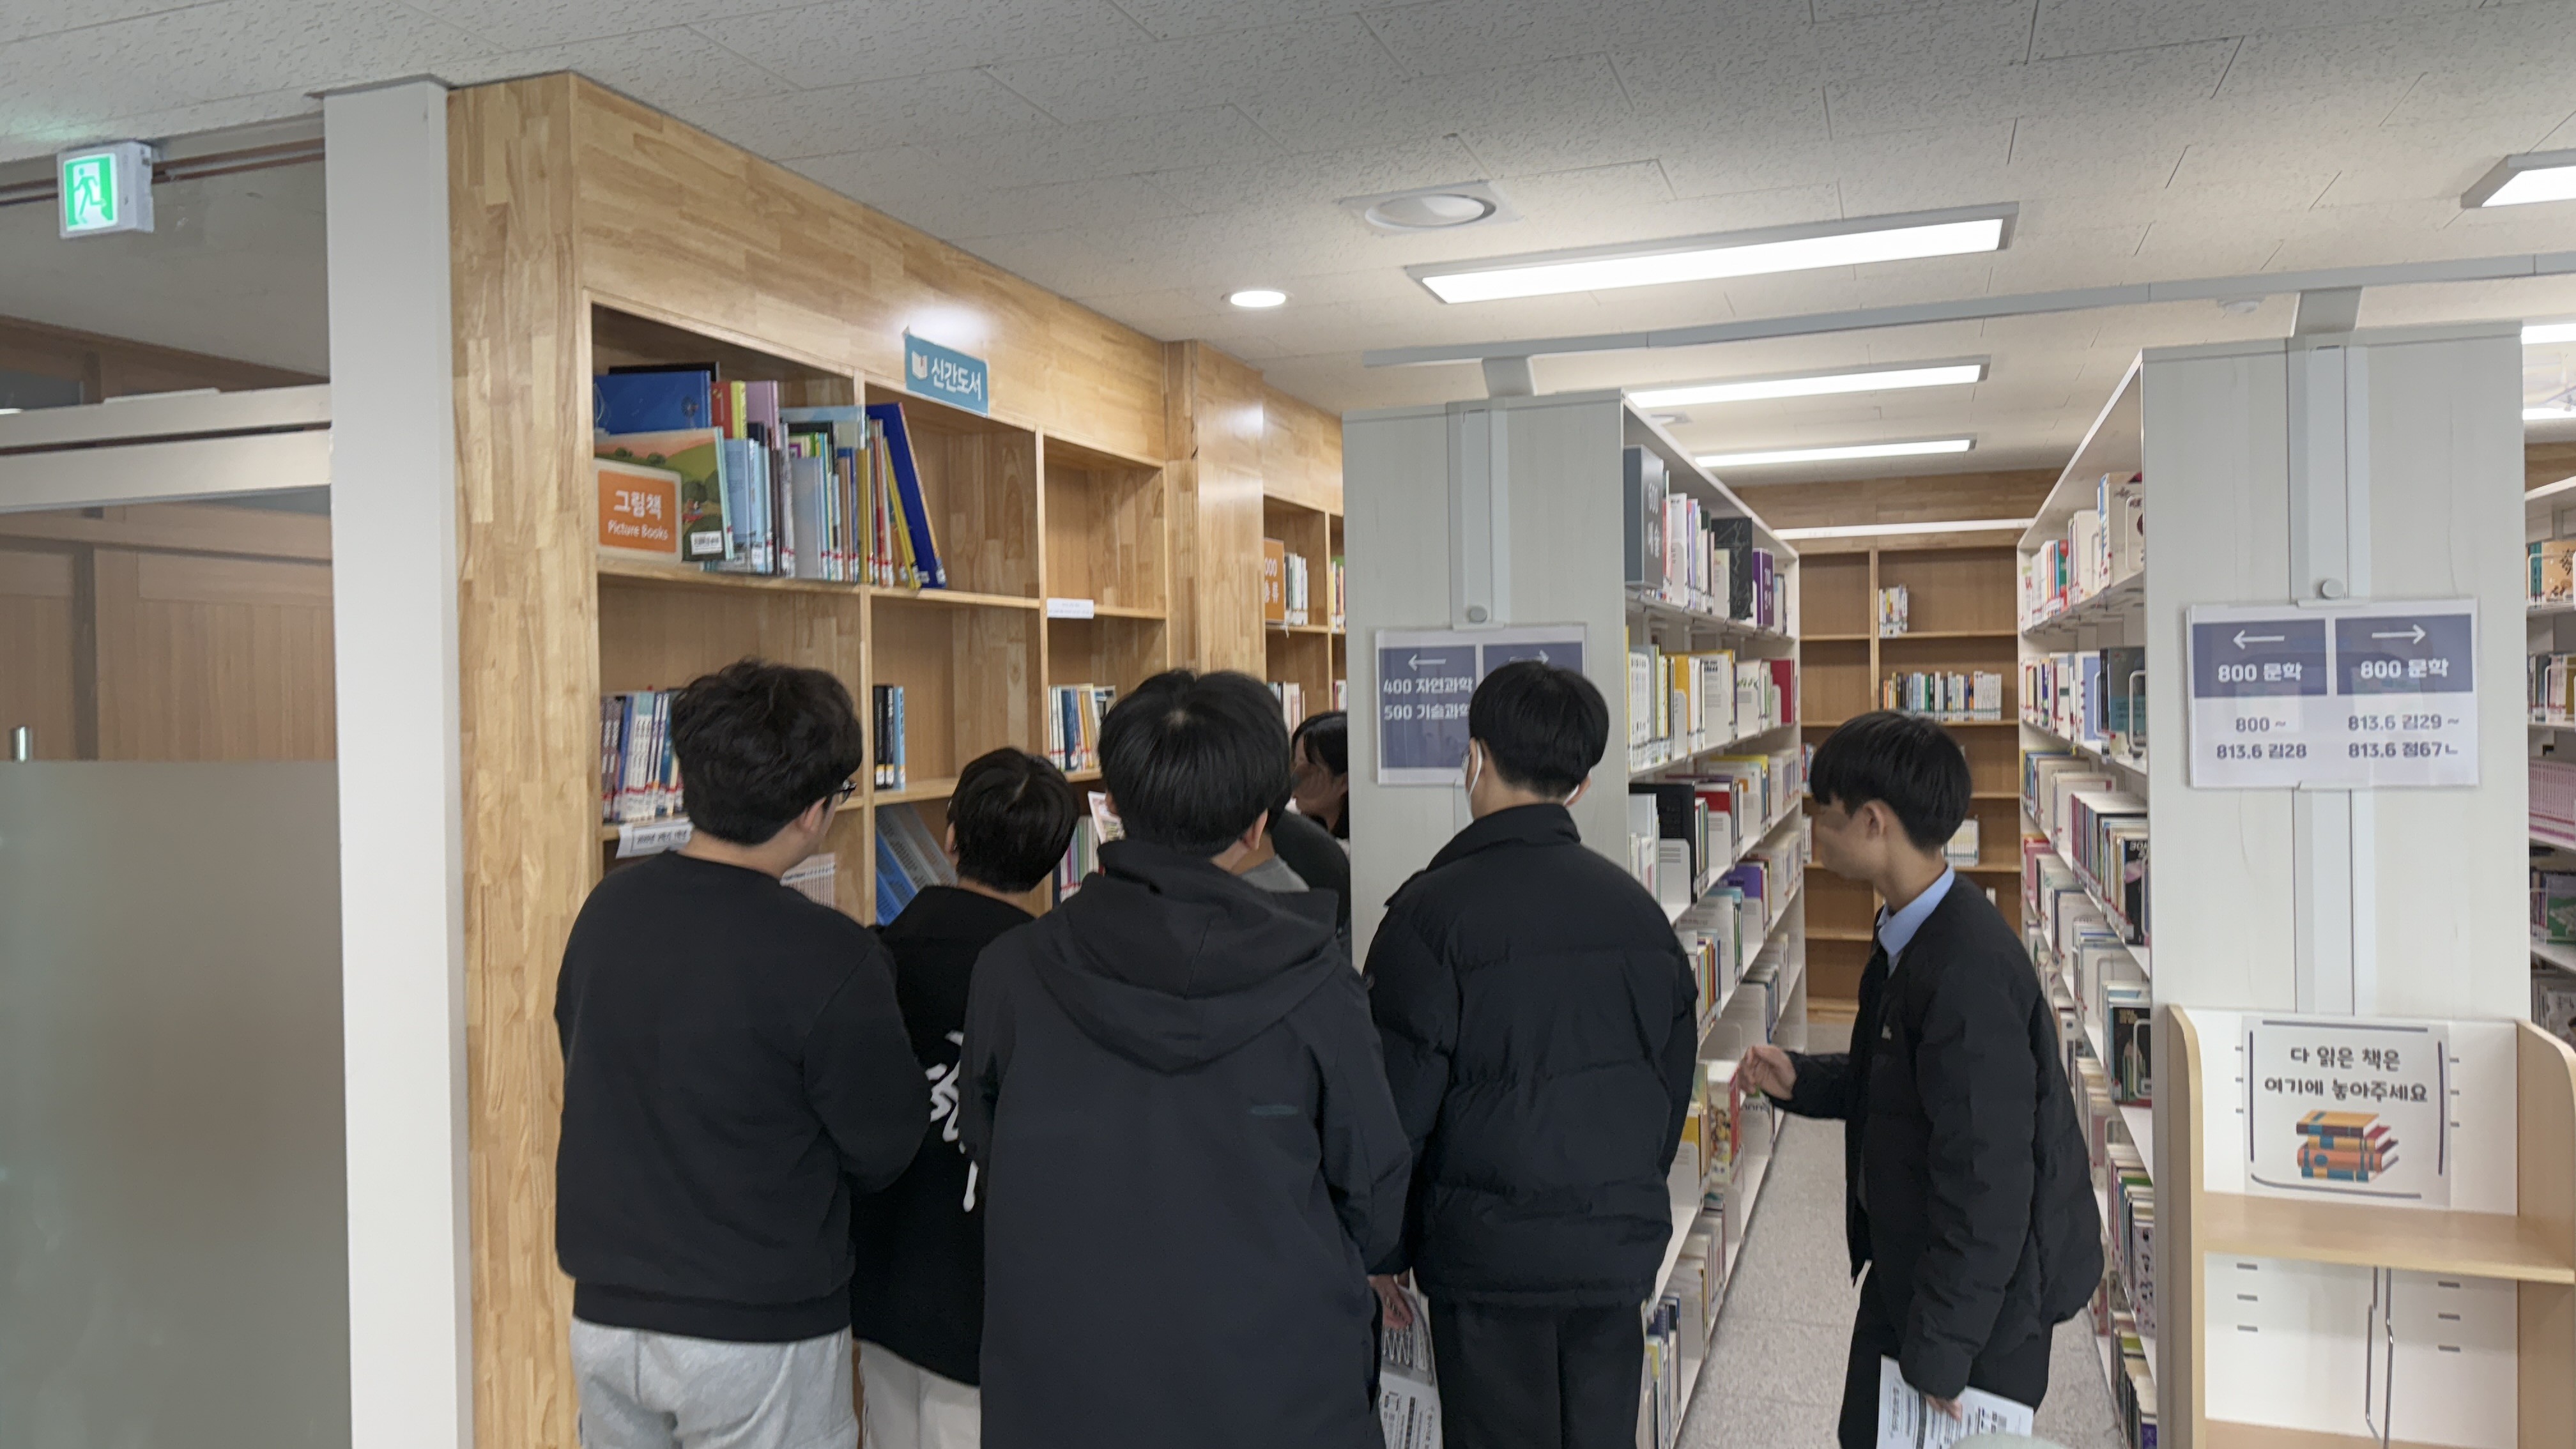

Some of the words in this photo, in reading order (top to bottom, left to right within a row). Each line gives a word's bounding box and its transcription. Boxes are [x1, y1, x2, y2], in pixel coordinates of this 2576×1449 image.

[931, 357, 982, 402] 신간도서
[613, 490, 662, 521] 그림책
[608, 519, 640, 538] Picture
[641, 524, 669, 541] Books
[2218, 664, 2257, 683] 800
[2264, 662, 2303, 682] 문학
[2361, 661, 2402, 678] 800
[2409, 658, 2449, 678] 문학
[1383, 678, 1412, 694] 400
[1415, 676, 1473, 694] 자연과학
[1384, 704, 1413, 721] 500
[2348, 714, 2396, 731] 813.6
[2235, 717, 2270, 732] 800
[2216, 744, 2262, 759] 813.6
[2348, 742, 2396, 758] 813.6
[2290, 1046, 2310, 1063] 다
[2317, 1046, 2354, 1069] 읽은
[2362, 1048, 2400, 1071] 책은
[2264, 1077, 2324, 1096] 여기에
[2332, 1078, 2428, 1103] 놓아주세요
